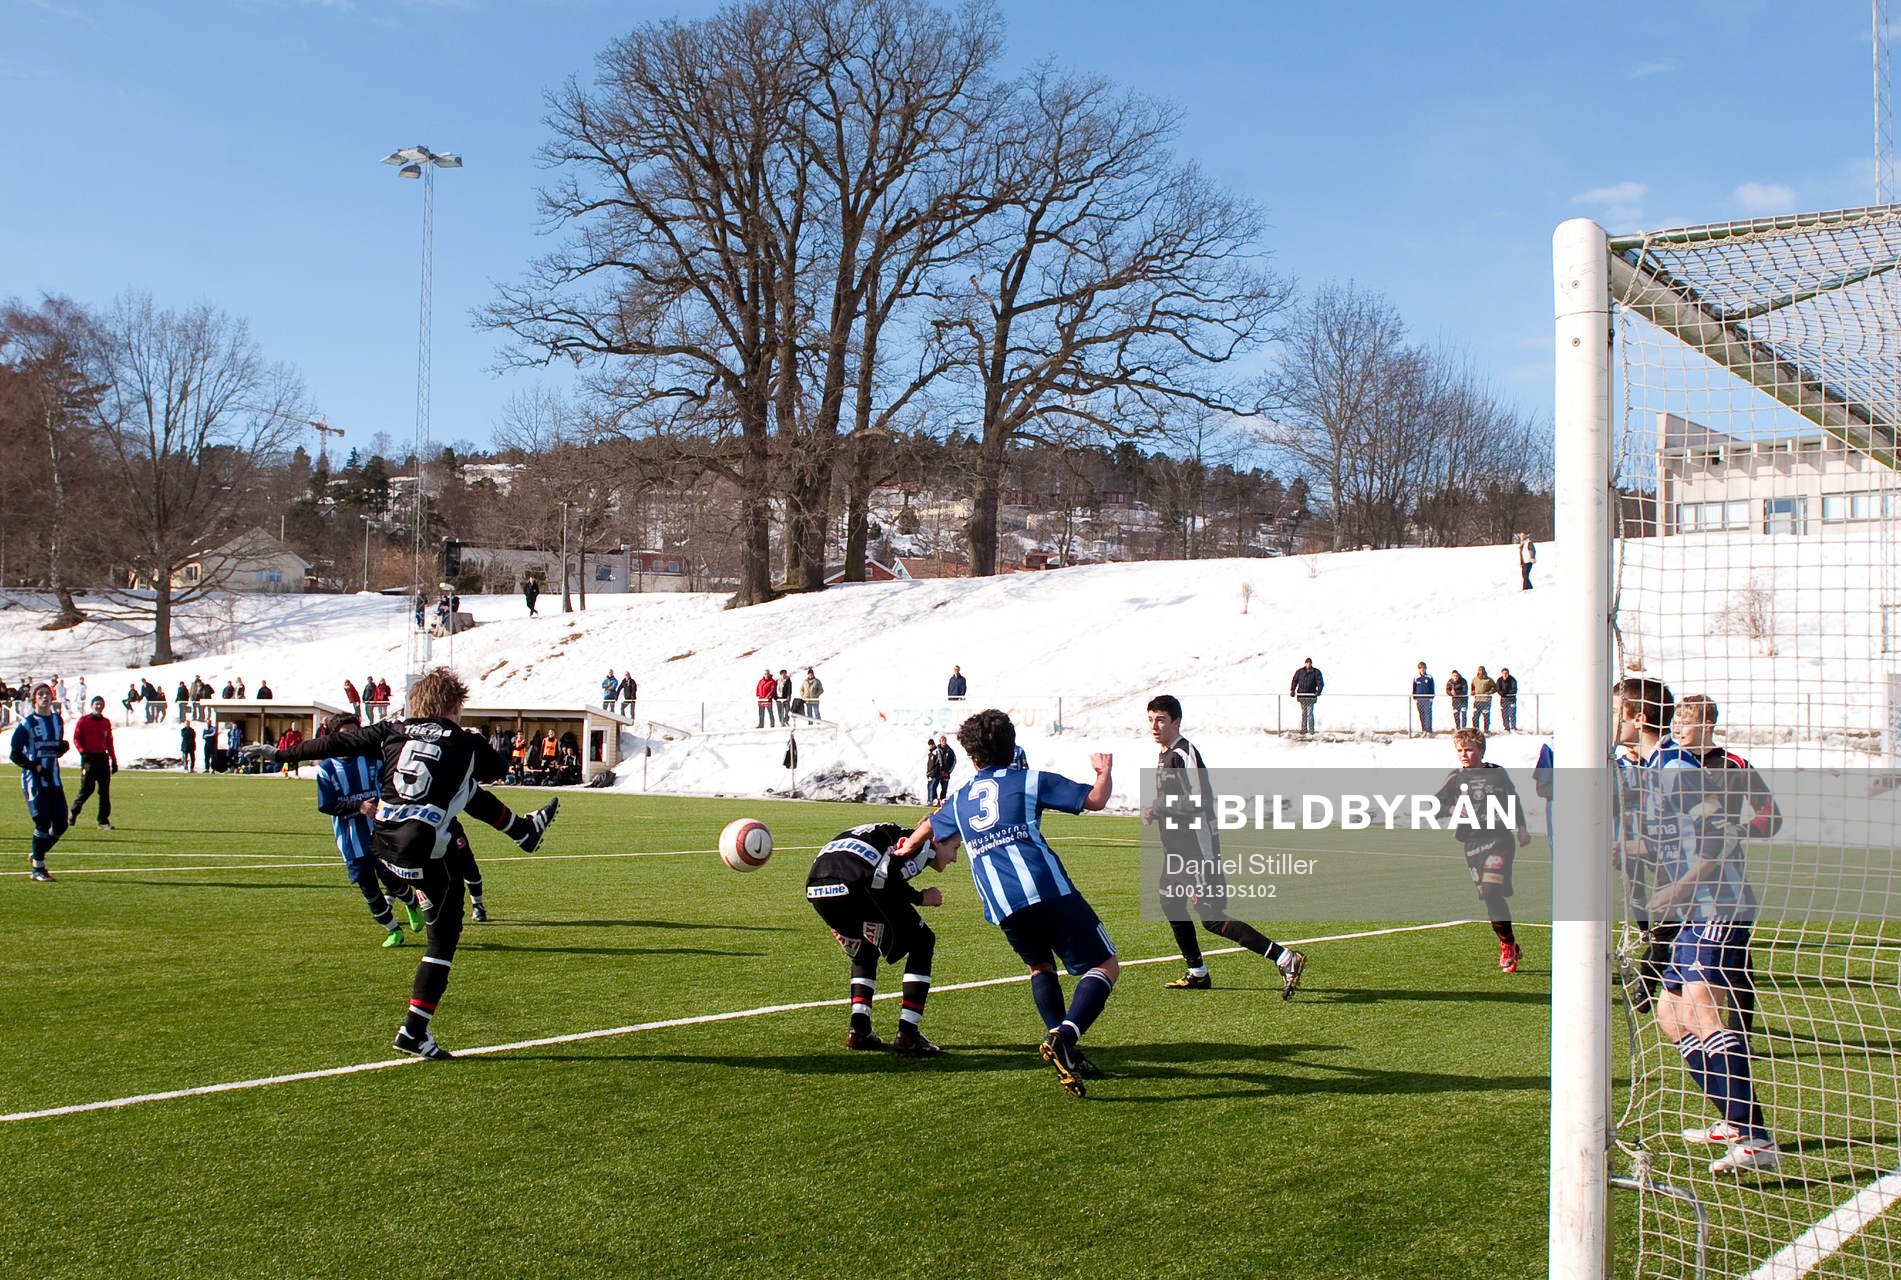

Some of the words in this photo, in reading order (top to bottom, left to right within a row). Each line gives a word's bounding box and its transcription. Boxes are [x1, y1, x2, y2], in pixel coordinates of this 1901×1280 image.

[893, 708, 933, 727] TIPS
[393, 740, 442, 801] 5
[968, 779, 999, 832] 3
